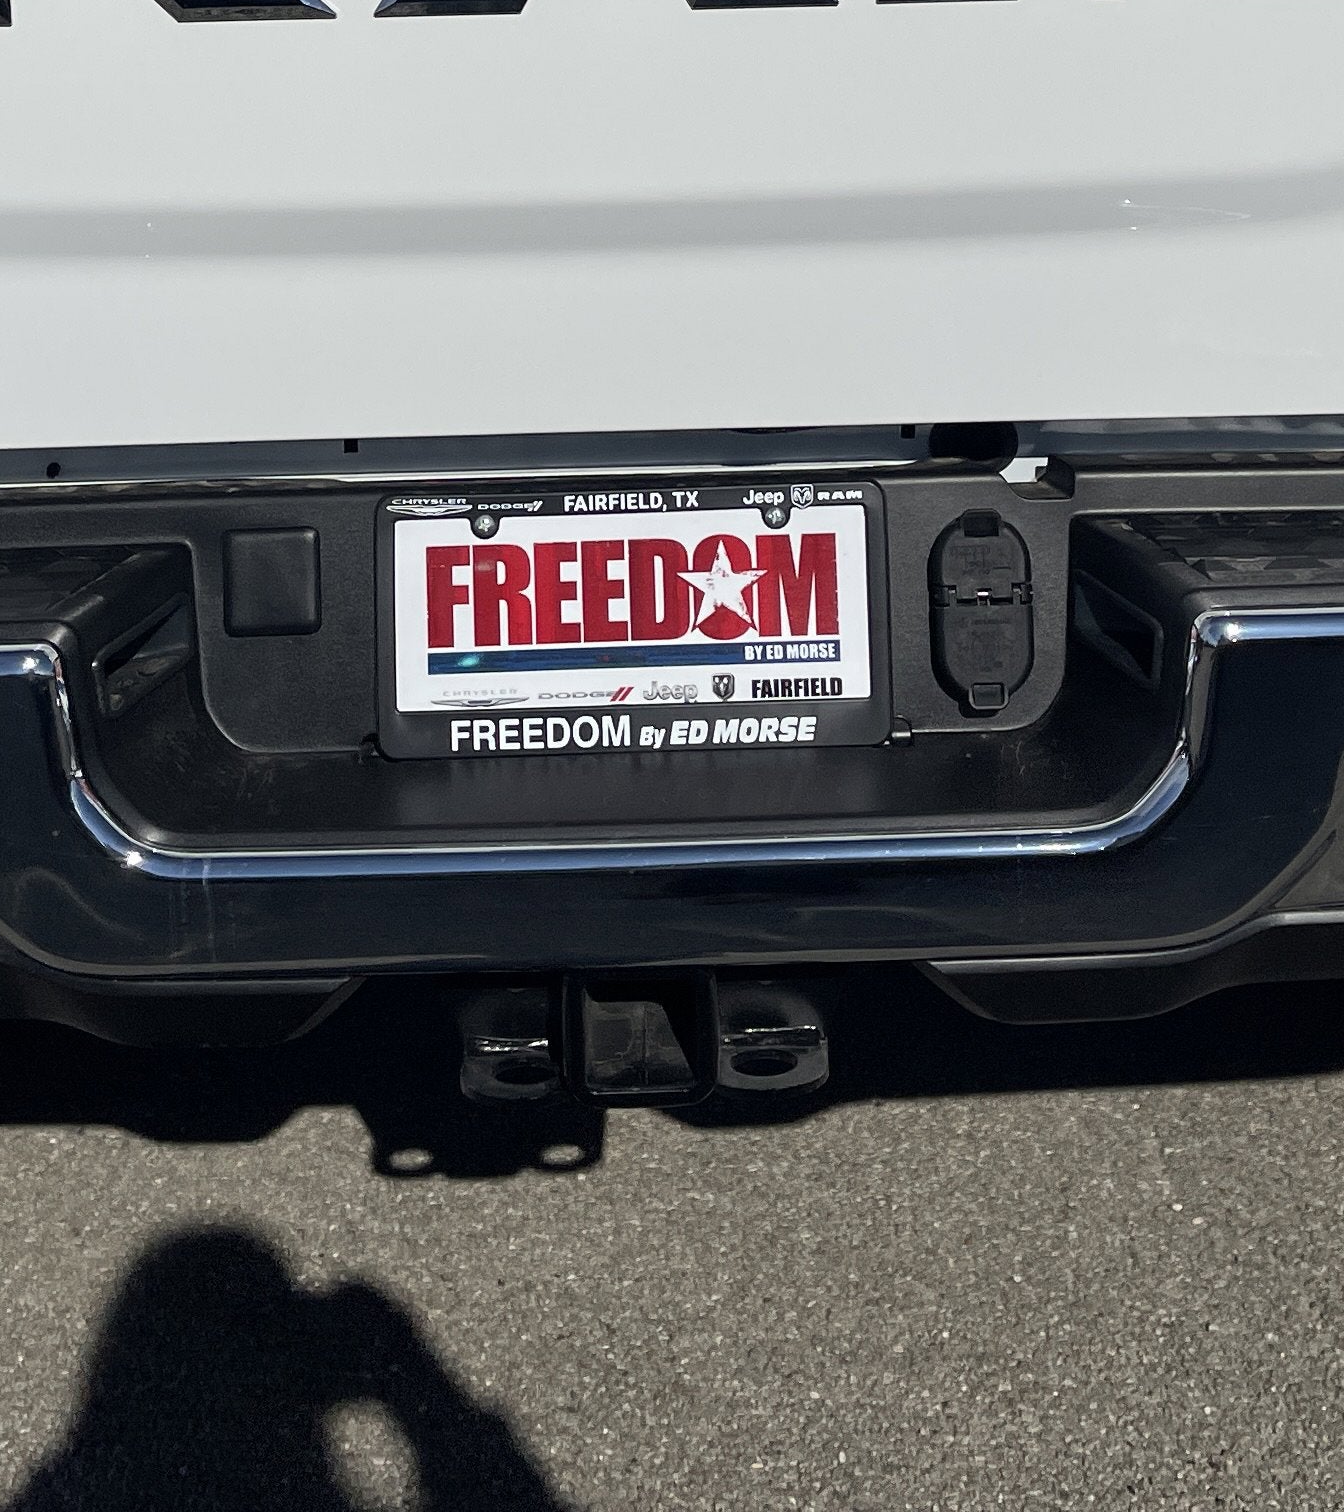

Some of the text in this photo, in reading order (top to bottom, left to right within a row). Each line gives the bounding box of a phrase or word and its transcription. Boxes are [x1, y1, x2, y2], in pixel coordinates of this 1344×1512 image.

[391, 497, 467, 506] CHRYSLER
[563, 490, 699, 513] FAIRFIELD, TX
[742, 489, 785, 506] Jeep
[816, 489, 863, 501] RAM
[425, 532, 840, 649] FREEDOM
[744, 642, 836, 661] BY ED MORSE
[442, 688, 518, 697] CHRYSLER
[642, 680, 699, 703] Jeep
[751, 677, 844, 699] FAIRFIELD
[451, 714, 817, 752] FREEDOM By ED MORSE
